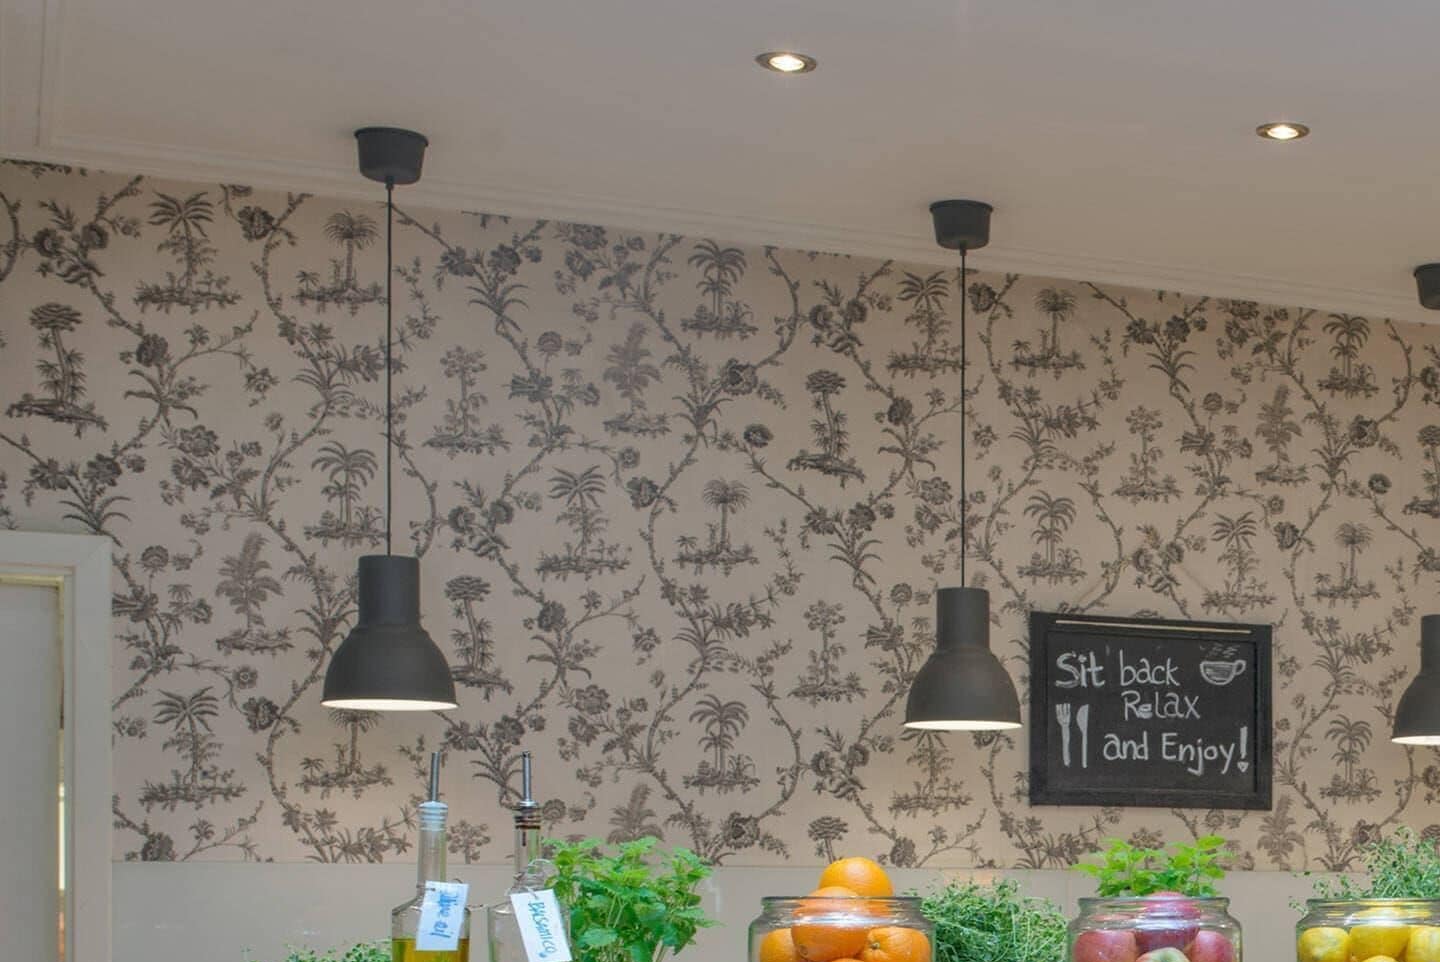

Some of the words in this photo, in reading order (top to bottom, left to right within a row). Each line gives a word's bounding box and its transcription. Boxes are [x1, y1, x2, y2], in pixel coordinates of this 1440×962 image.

[1055, 651, 1106, 688] Sit
[1119, 648, 1180, 687] back
[1121, 690, 1201, 721] Relax
[1103, 730, 1149, 761] and
[1161, 725, 1249, 776] Enjoy!
